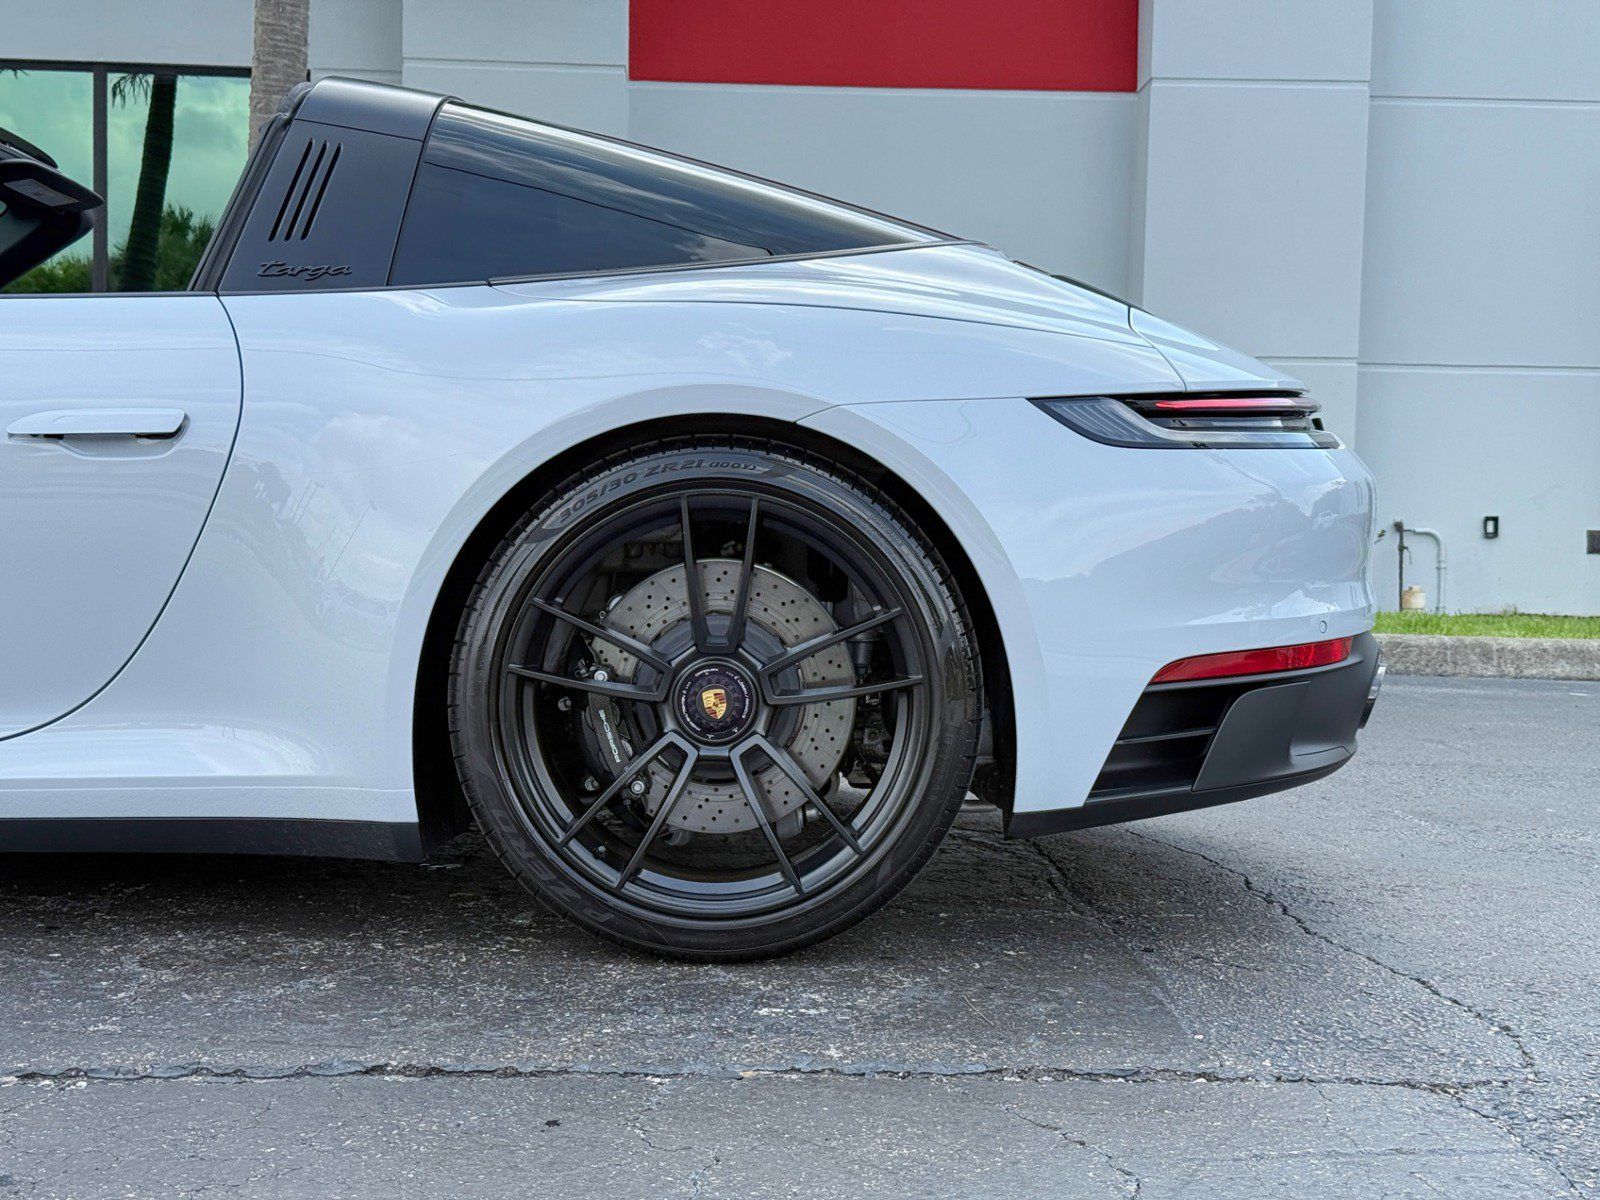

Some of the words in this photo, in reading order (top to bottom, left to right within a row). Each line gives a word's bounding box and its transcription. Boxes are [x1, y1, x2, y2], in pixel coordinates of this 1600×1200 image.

[560, 473, 637, 523] 305/30
[643, 459, 703, 478] ZR21
[599, 709, 621, 763] PORSCHE
